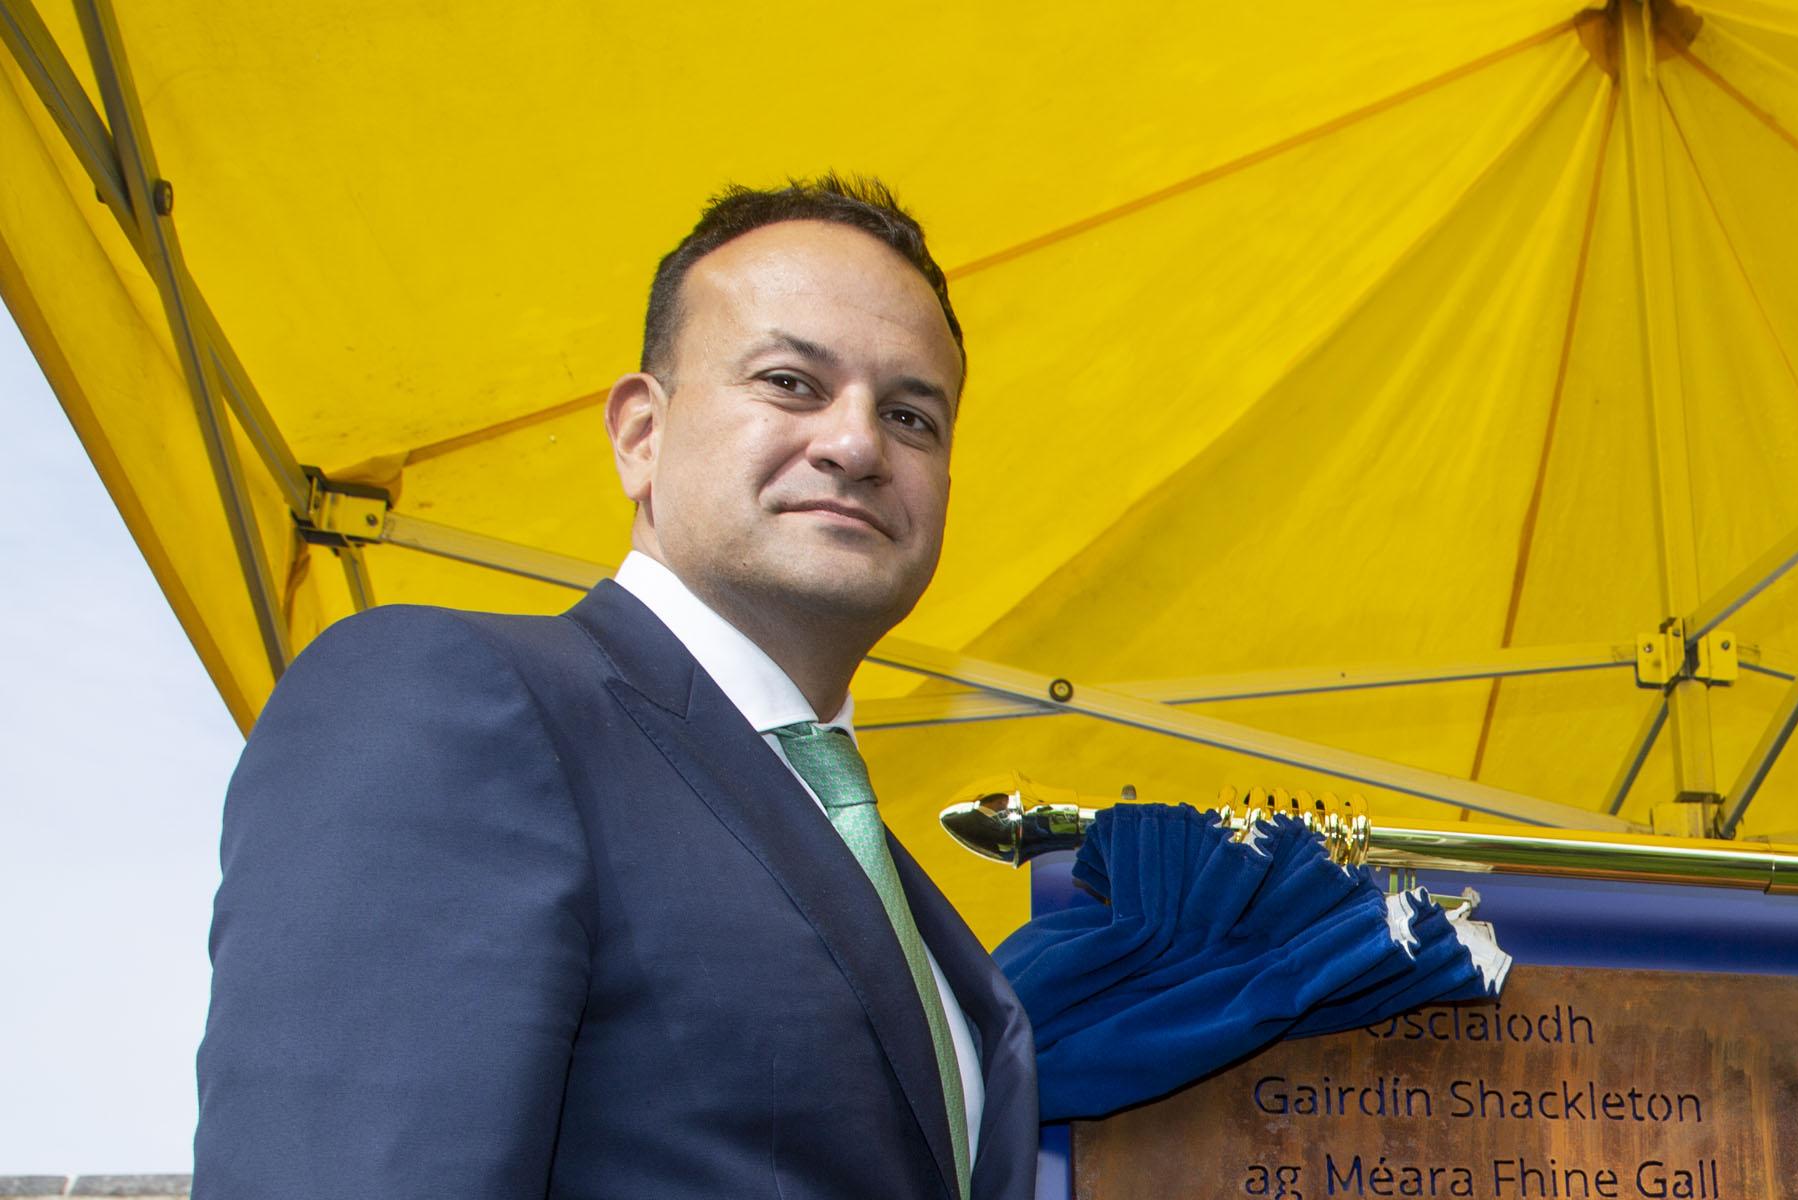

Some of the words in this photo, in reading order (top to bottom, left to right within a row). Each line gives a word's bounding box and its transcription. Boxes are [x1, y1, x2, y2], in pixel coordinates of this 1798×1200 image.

[1253, 1076, 1432, 1119] Gairdín
[1450, 1079, 1704, 1124] Shackleton
[1326, 1154, 1475, 1199] Méara
[1494, 1158, 1619, 1200] Fhine
[1635, 1159, 1721, 1200] Gall
